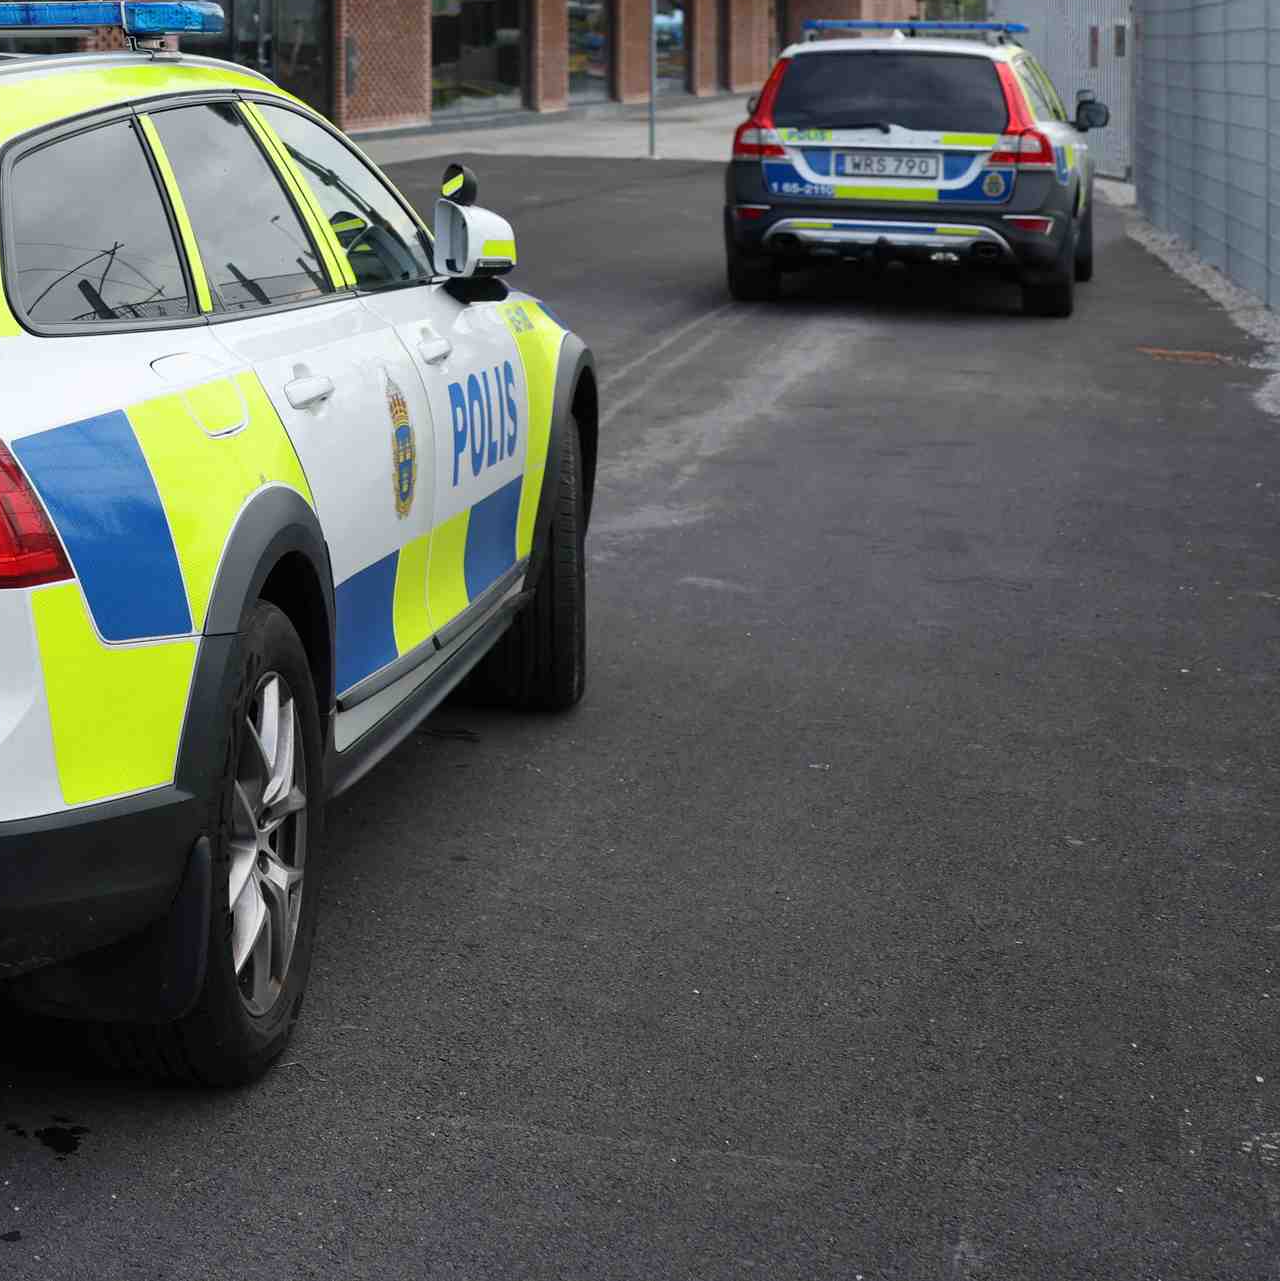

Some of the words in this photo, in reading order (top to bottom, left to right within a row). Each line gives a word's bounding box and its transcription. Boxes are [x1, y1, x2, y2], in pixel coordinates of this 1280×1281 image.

[850, 157, 887, 171] WRS
[893, 158, 930, 174] 790
[448, 360, 518, 488] POLIS
